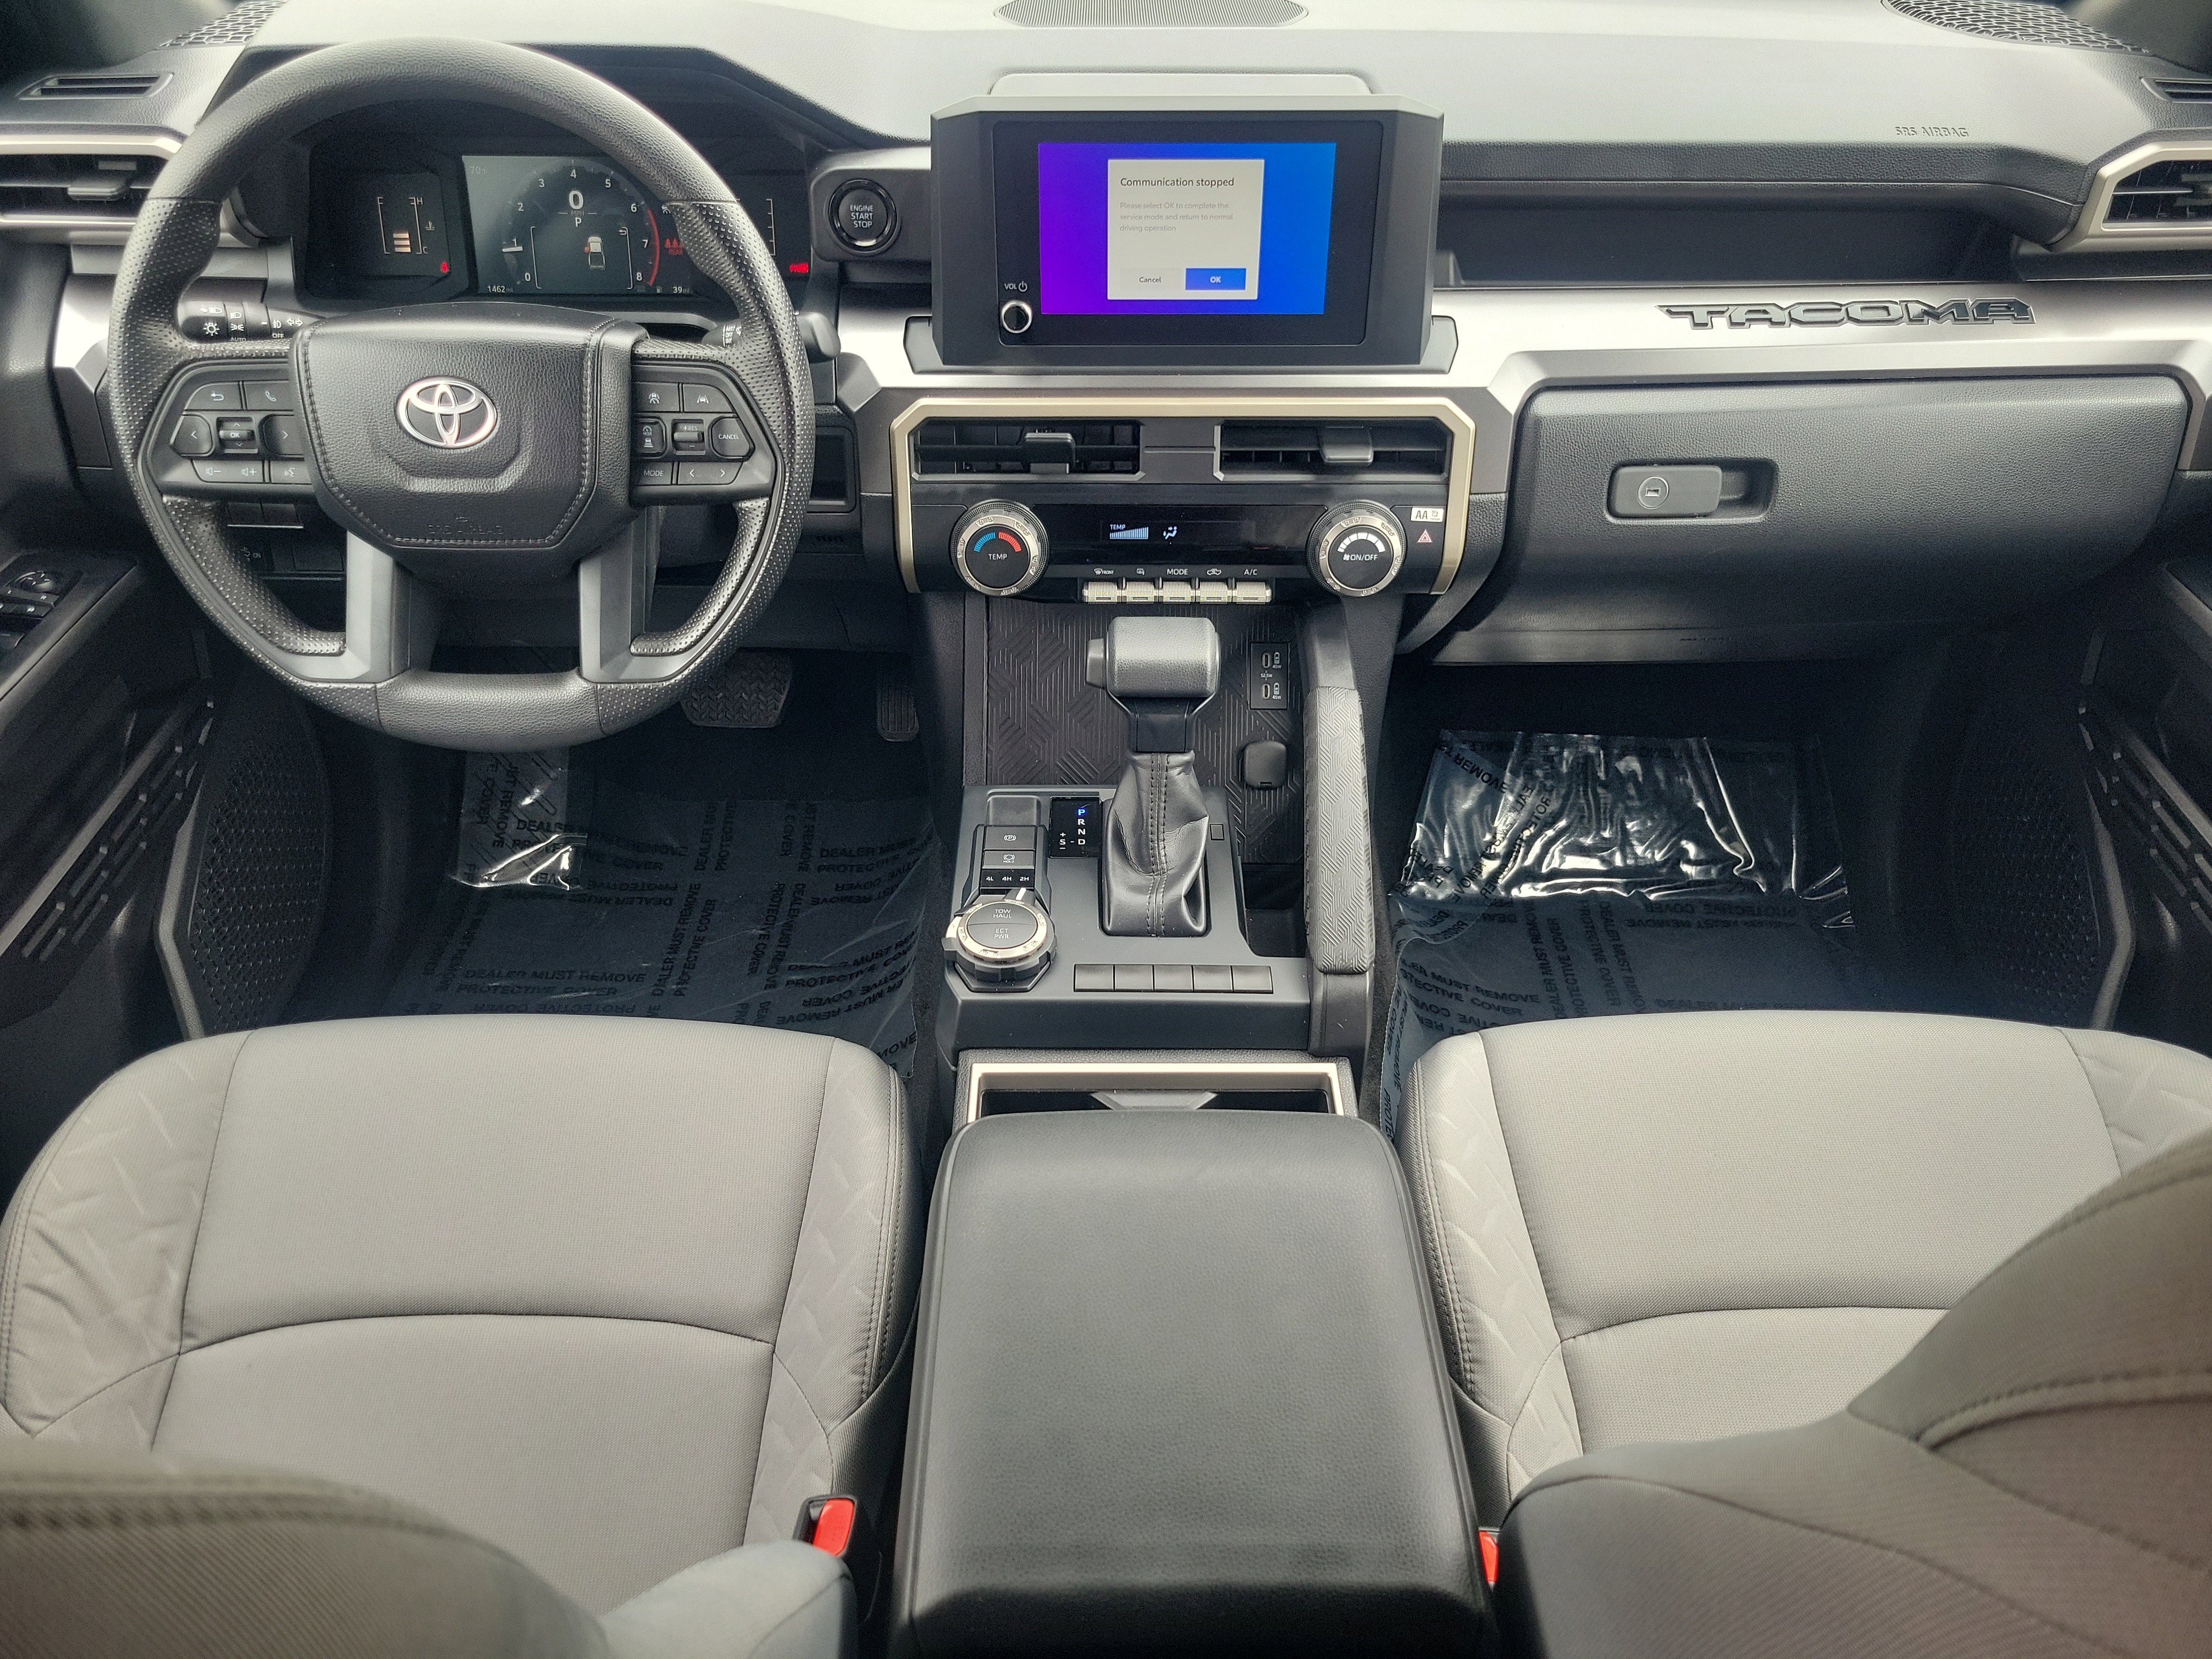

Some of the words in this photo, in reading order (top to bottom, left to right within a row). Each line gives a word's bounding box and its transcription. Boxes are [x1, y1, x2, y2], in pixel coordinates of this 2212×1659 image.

[1895, 126, 1917, 136] SRS
[1921, 126, 1969, 137] AIRBAG
[570, 169, 577, 179] 4
[538, 178, 545, 188] 3
[605, 179, 611, 188] 5
[1120, 178, 1193, 187] Communication
[1196, 178, 1234, 188] stopped
[416, 197, 423, 205] H
[569, 190, 584, 210] 0
[517, 202, 524, 212] 2
[630, 204, 637, 213] 6
[575, 217, 582, 227] P
[642, 239, 648, 248] 7
[524, 273, 531, 281] 0
[636, 272, 642, 281] 8
[1655, 298, 2036, 329] TACOMA
[1415, 510, 1427, 520] AA
[531, 969, 576, 980] MUST
[578, 971, 647, 983] REMOVE
[1430, 971, 1471, 992] MUST
[1474, 985, 1542, 1004] REMOVE
[1470, 996, 1523, 1015] COVER
